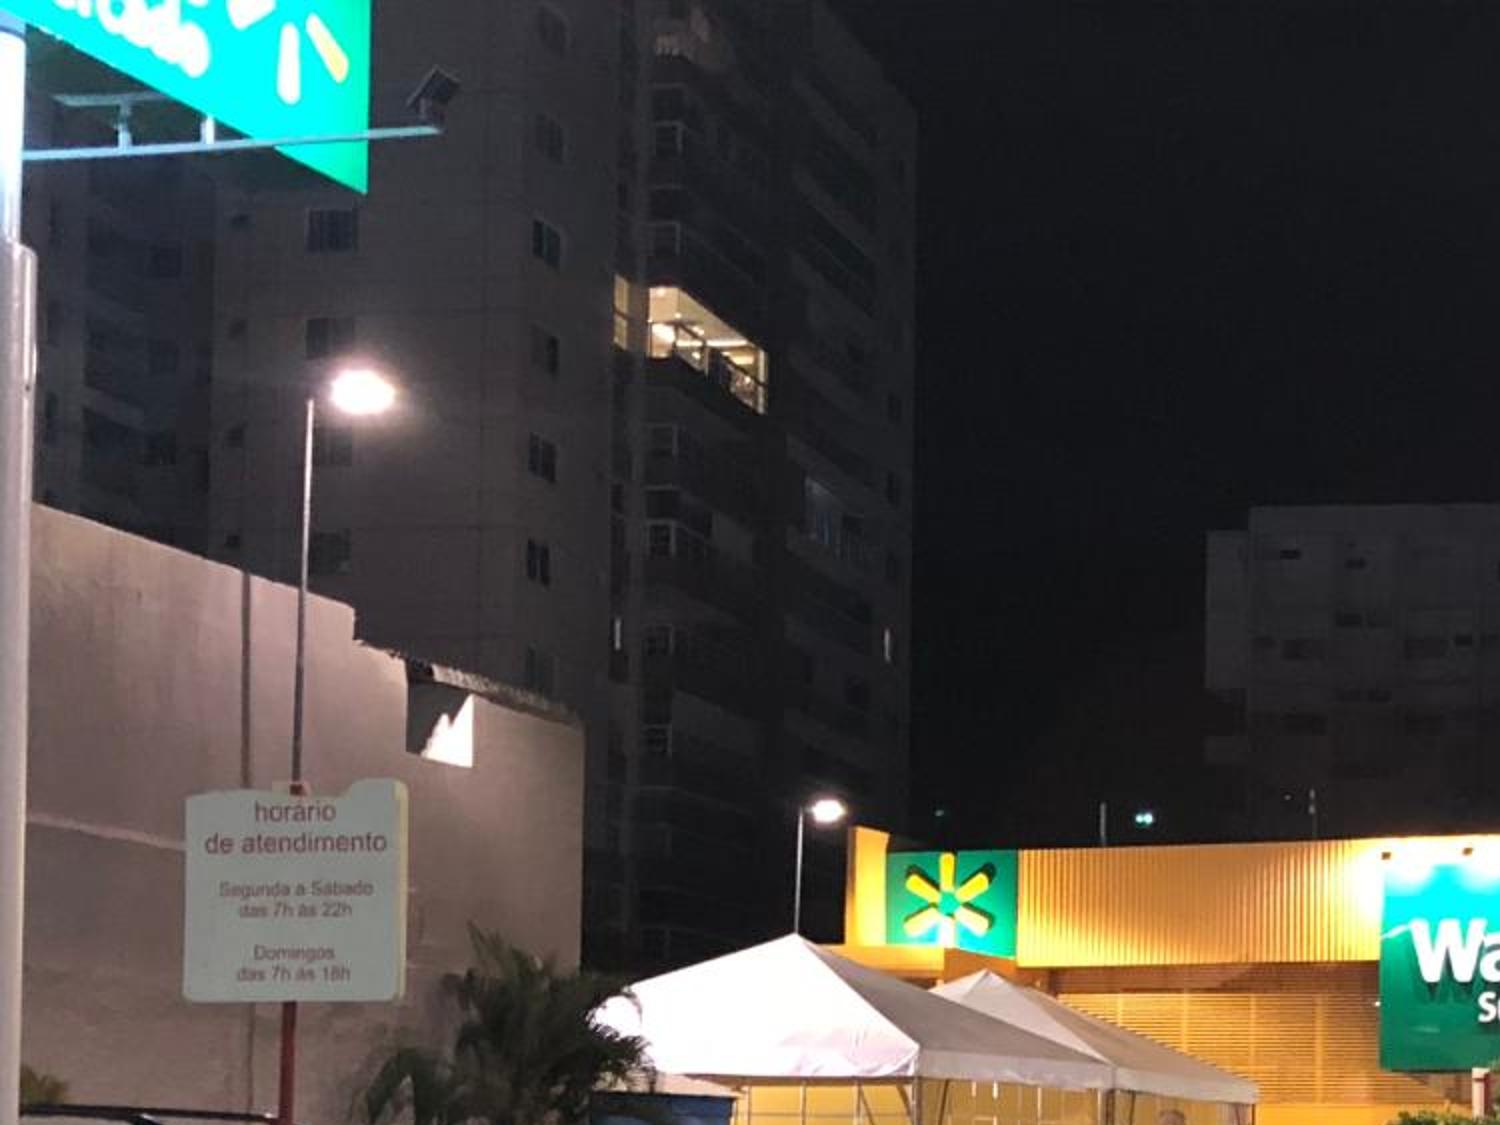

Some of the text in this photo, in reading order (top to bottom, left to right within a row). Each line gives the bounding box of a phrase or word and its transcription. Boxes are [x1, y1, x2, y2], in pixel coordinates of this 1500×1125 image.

[204, 832, 387, 855] de atendimento
[219, 881, 290, 898] Segunda
[238, 902, 267, 918] das
[273, 902, 294, 918] 7h
[322, 902, 352, 917] 22h
[253, 945, 335, 963] Domingos
[237, 967, 266, 982] das
[272, 967, 291, 981] 7h
[323, 966, 350, 981] 18h
